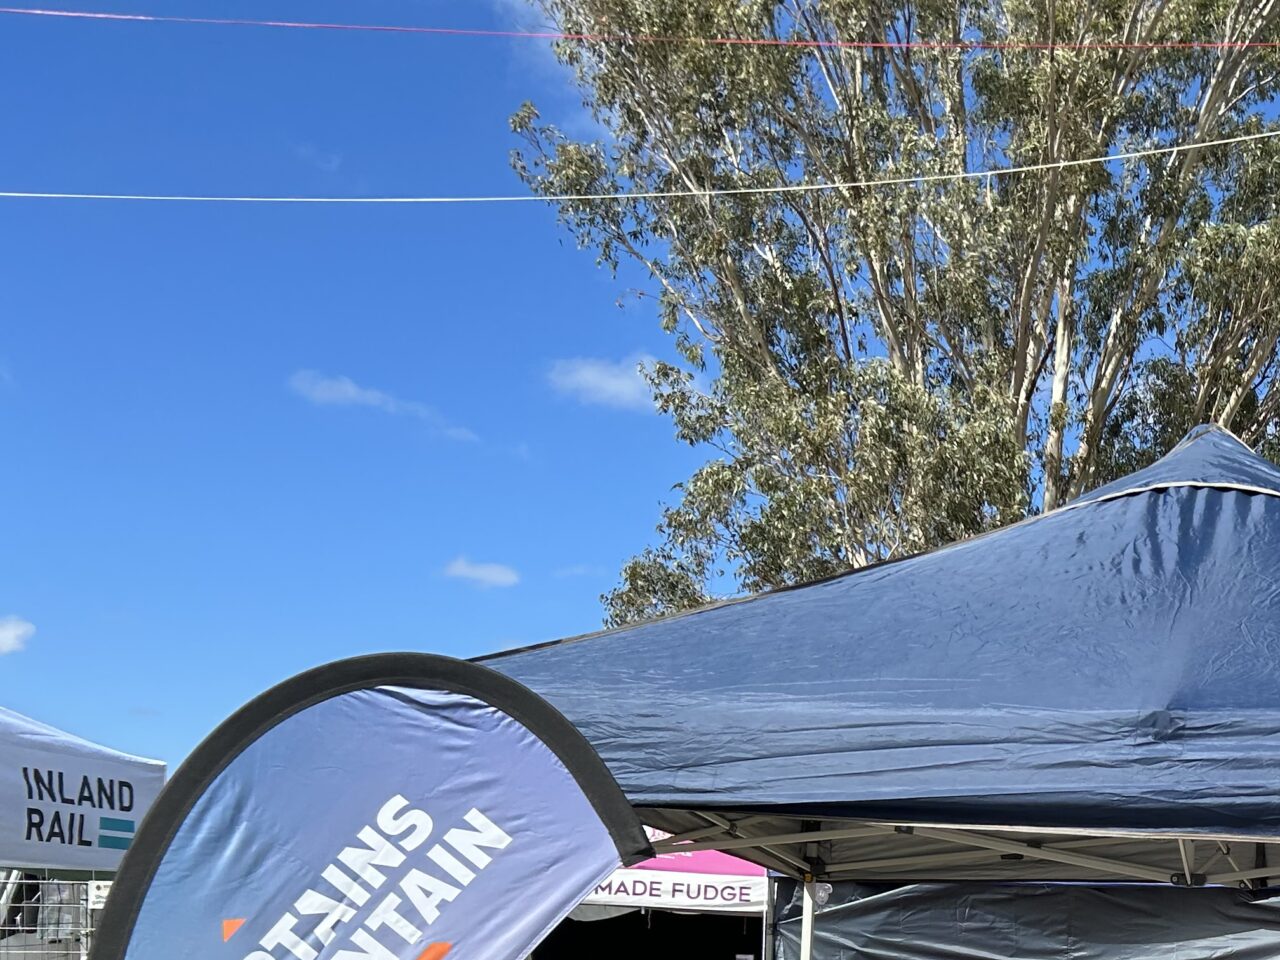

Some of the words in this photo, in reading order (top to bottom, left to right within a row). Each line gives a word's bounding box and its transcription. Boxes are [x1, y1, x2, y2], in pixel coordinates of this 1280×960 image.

[22, 767, 134, 812] INLAND
[25, 807, 92, 846] RAIL
[671, 882, 752, 902] FUDGE
